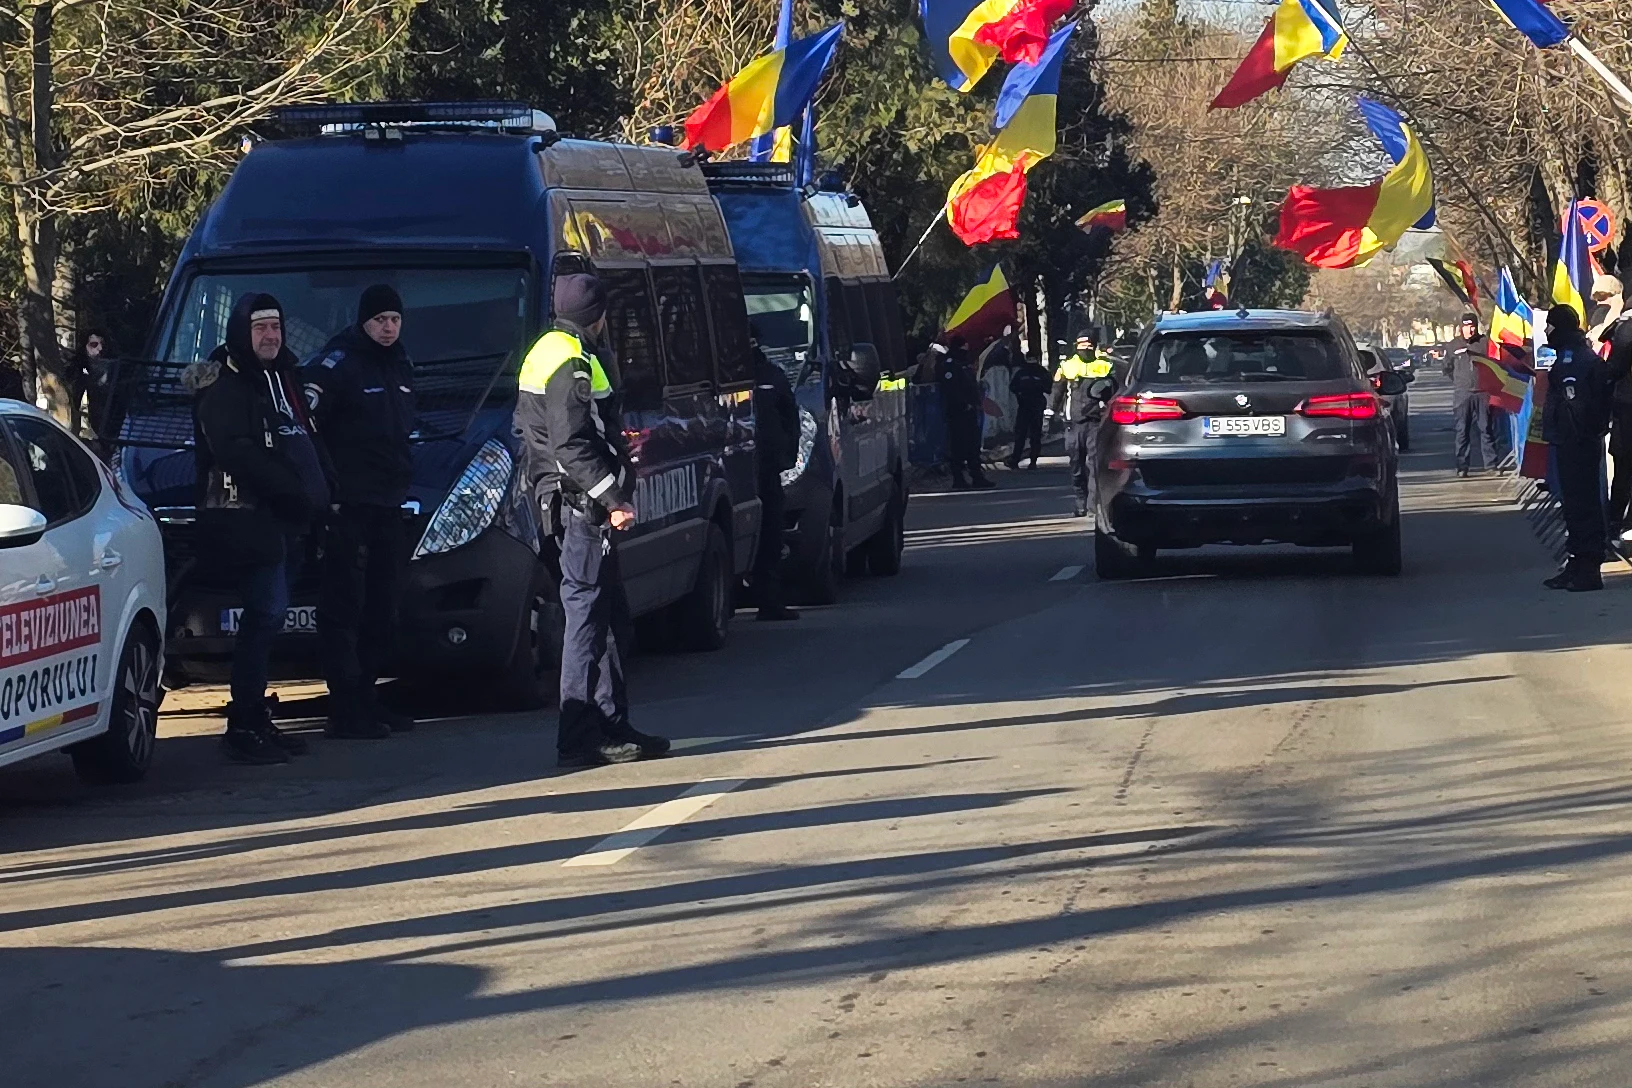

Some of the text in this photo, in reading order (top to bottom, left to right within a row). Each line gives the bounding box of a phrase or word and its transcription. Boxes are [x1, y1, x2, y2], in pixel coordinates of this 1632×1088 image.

[1211, 419, 1221, 432] B
[0, 594, 99, 658] ELEVIZIUNEA
[1, 653, 98, 721] OPORULUI
